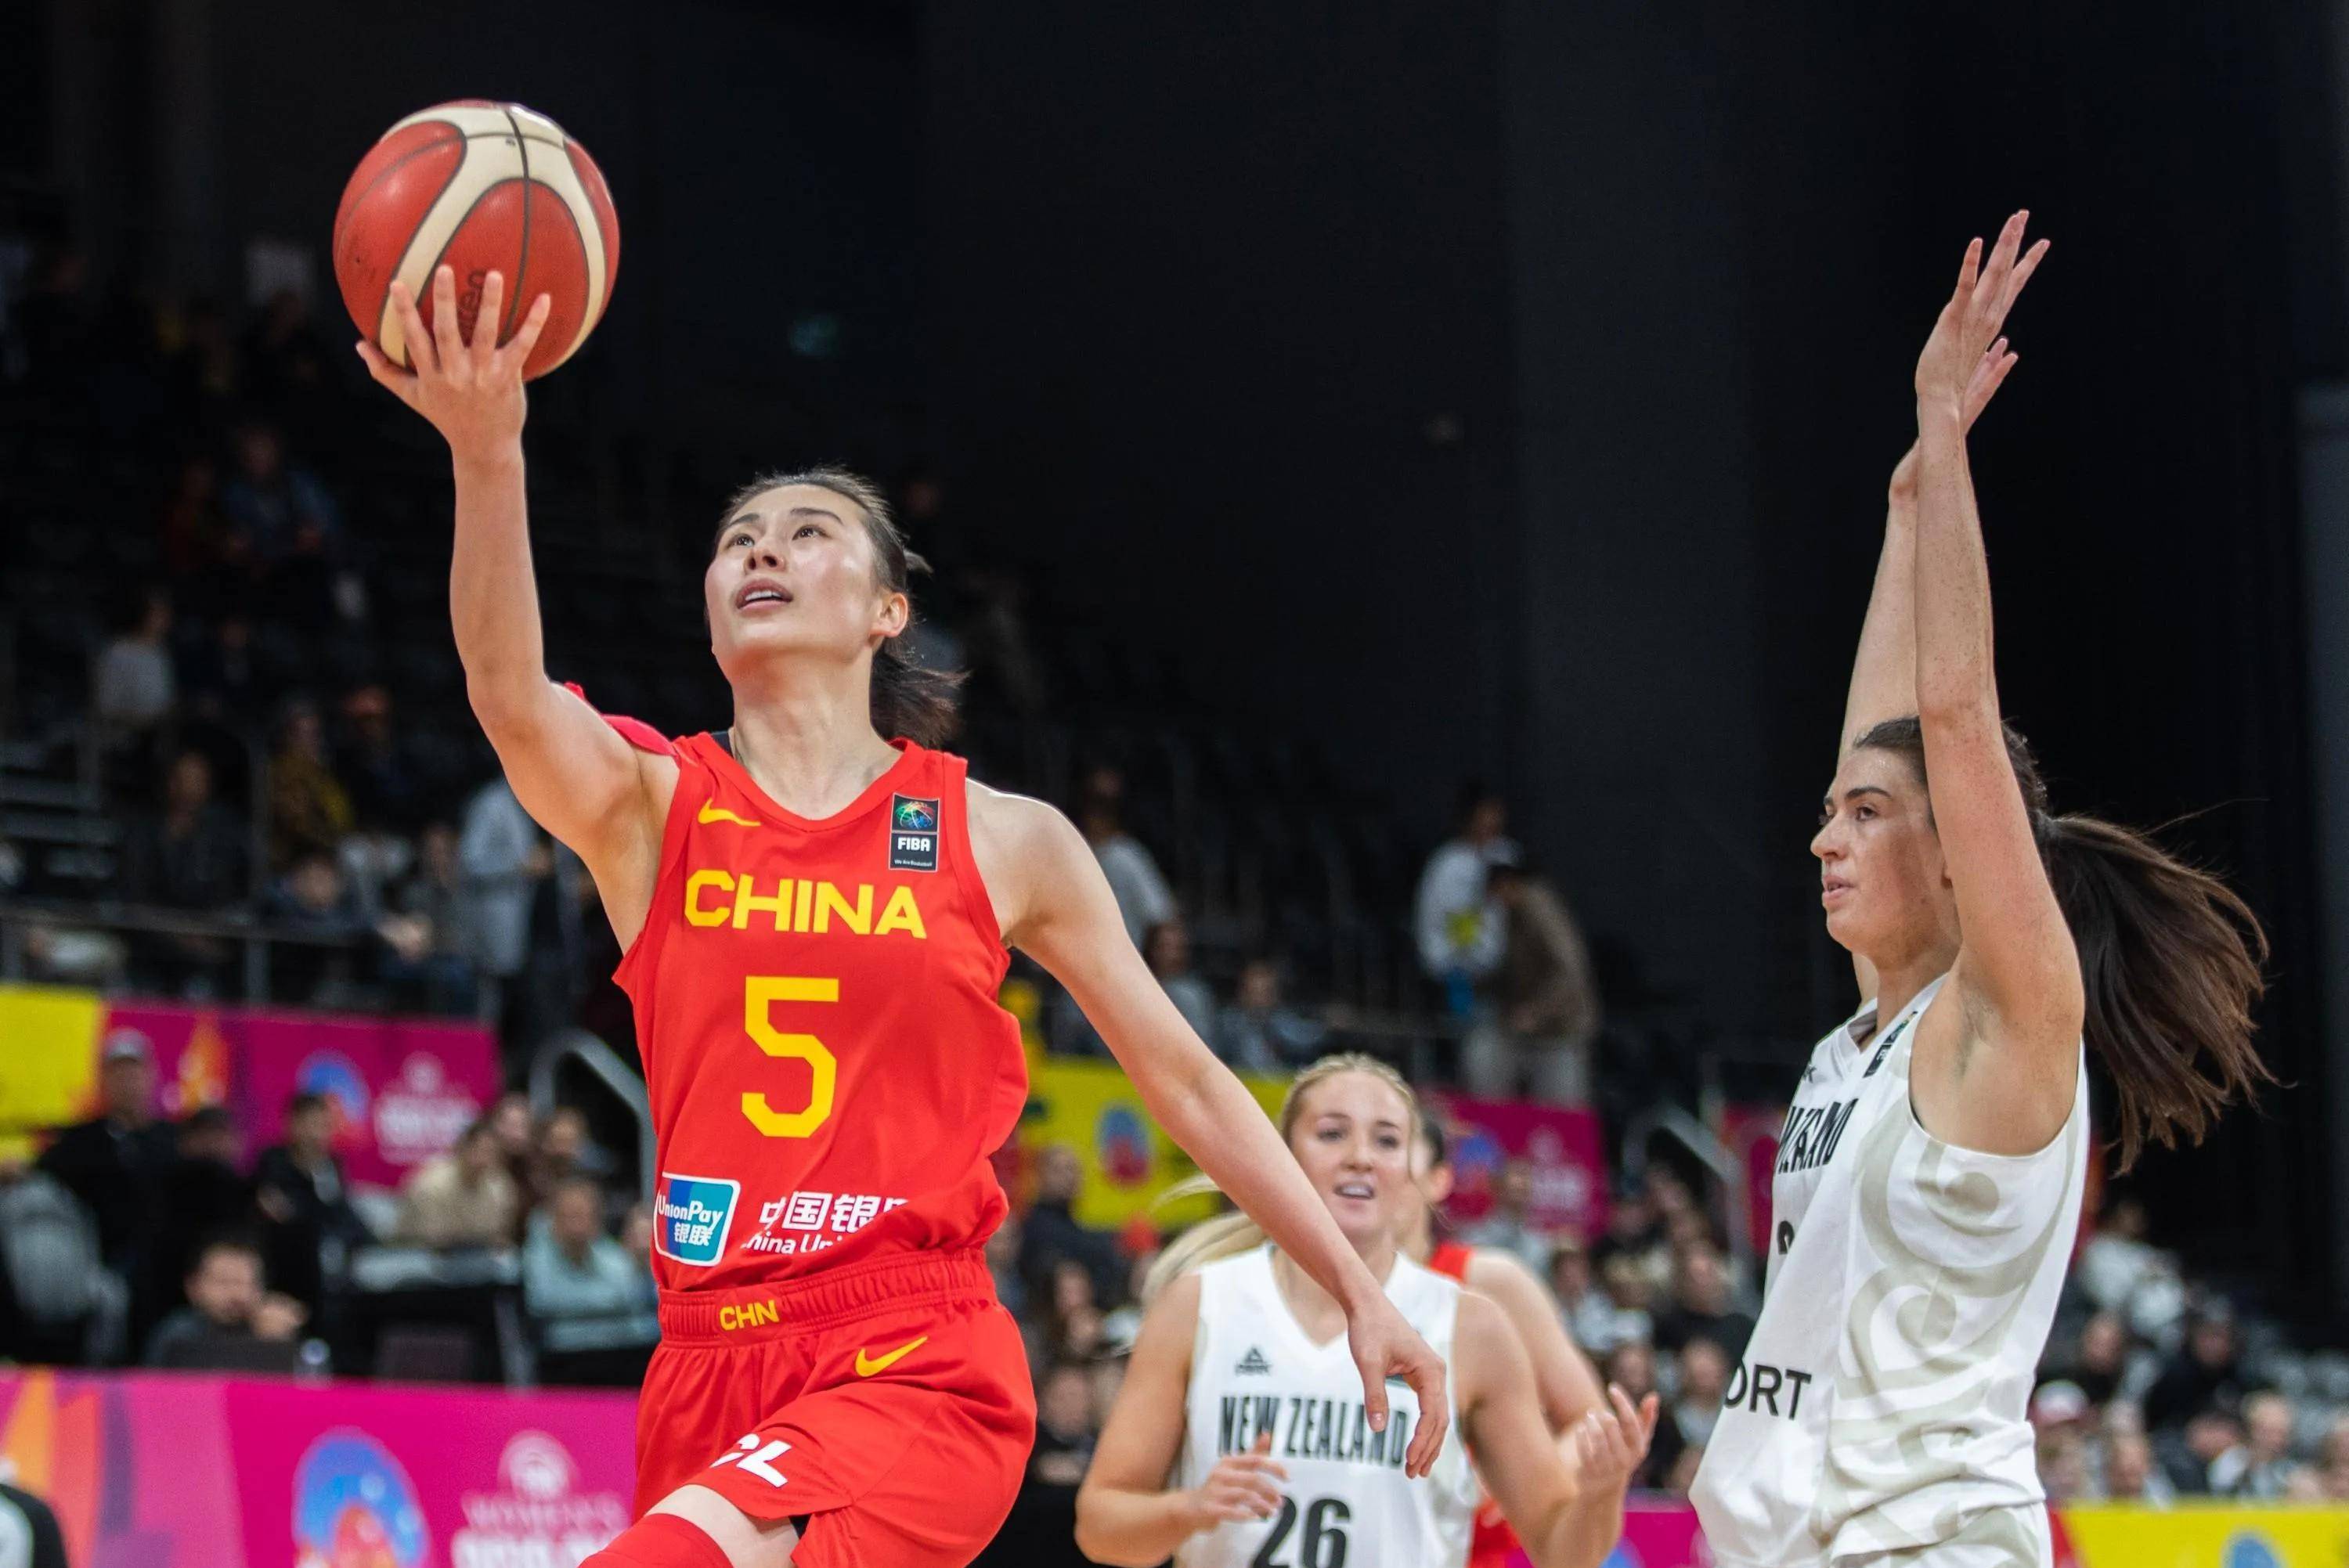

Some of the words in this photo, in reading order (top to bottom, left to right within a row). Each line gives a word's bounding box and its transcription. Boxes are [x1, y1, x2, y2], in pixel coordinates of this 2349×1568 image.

[897, 837, 930, 852] FIBA
[684, 869, 927, 939] CHINA
[742, 975, 839, 1138] 5
[658, 1195, 723, 1232] UnionPay
[674, 1221, 713, 1247] 银联
[740, 1231, 796, 1255] hina
[720, 1299, 780, 1331] CHN
[1253, 1494, 1350, 1568] 26
